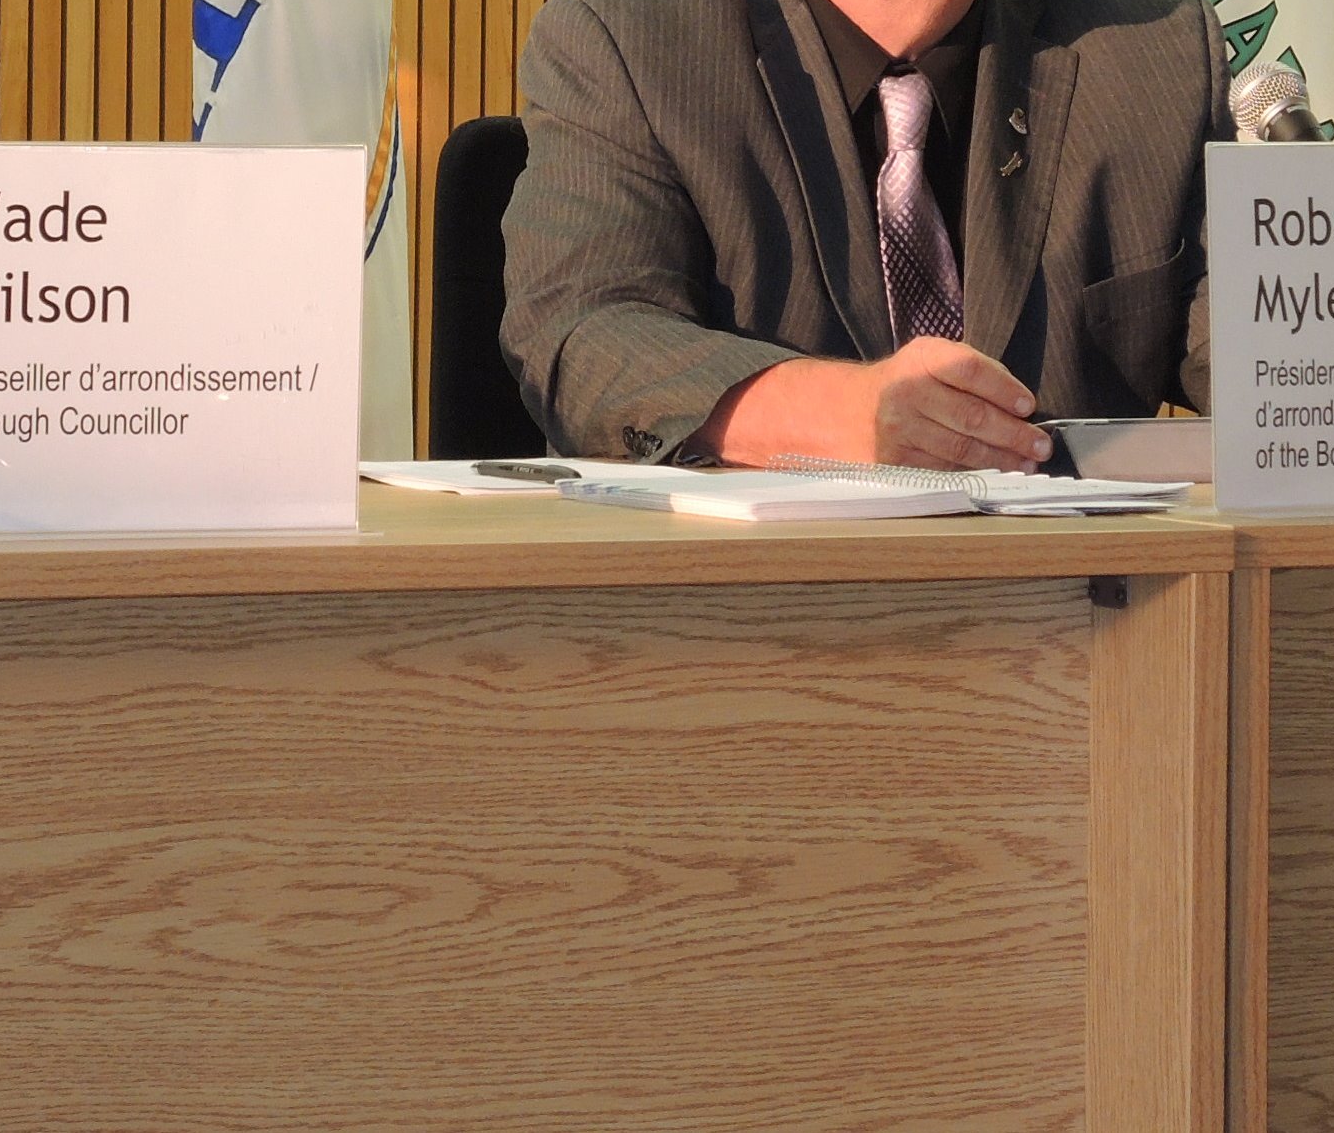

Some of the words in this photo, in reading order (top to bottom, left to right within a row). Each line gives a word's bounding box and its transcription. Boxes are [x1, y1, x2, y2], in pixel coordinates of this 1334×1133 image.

[79, 362, 303, 393] d'arrondissement
[309, 363, 319, 393] /
[59, 405, 190, 435] Councillor
[1255, 441, 1276, 469] of
[1280, 441, 1310, 469] the
